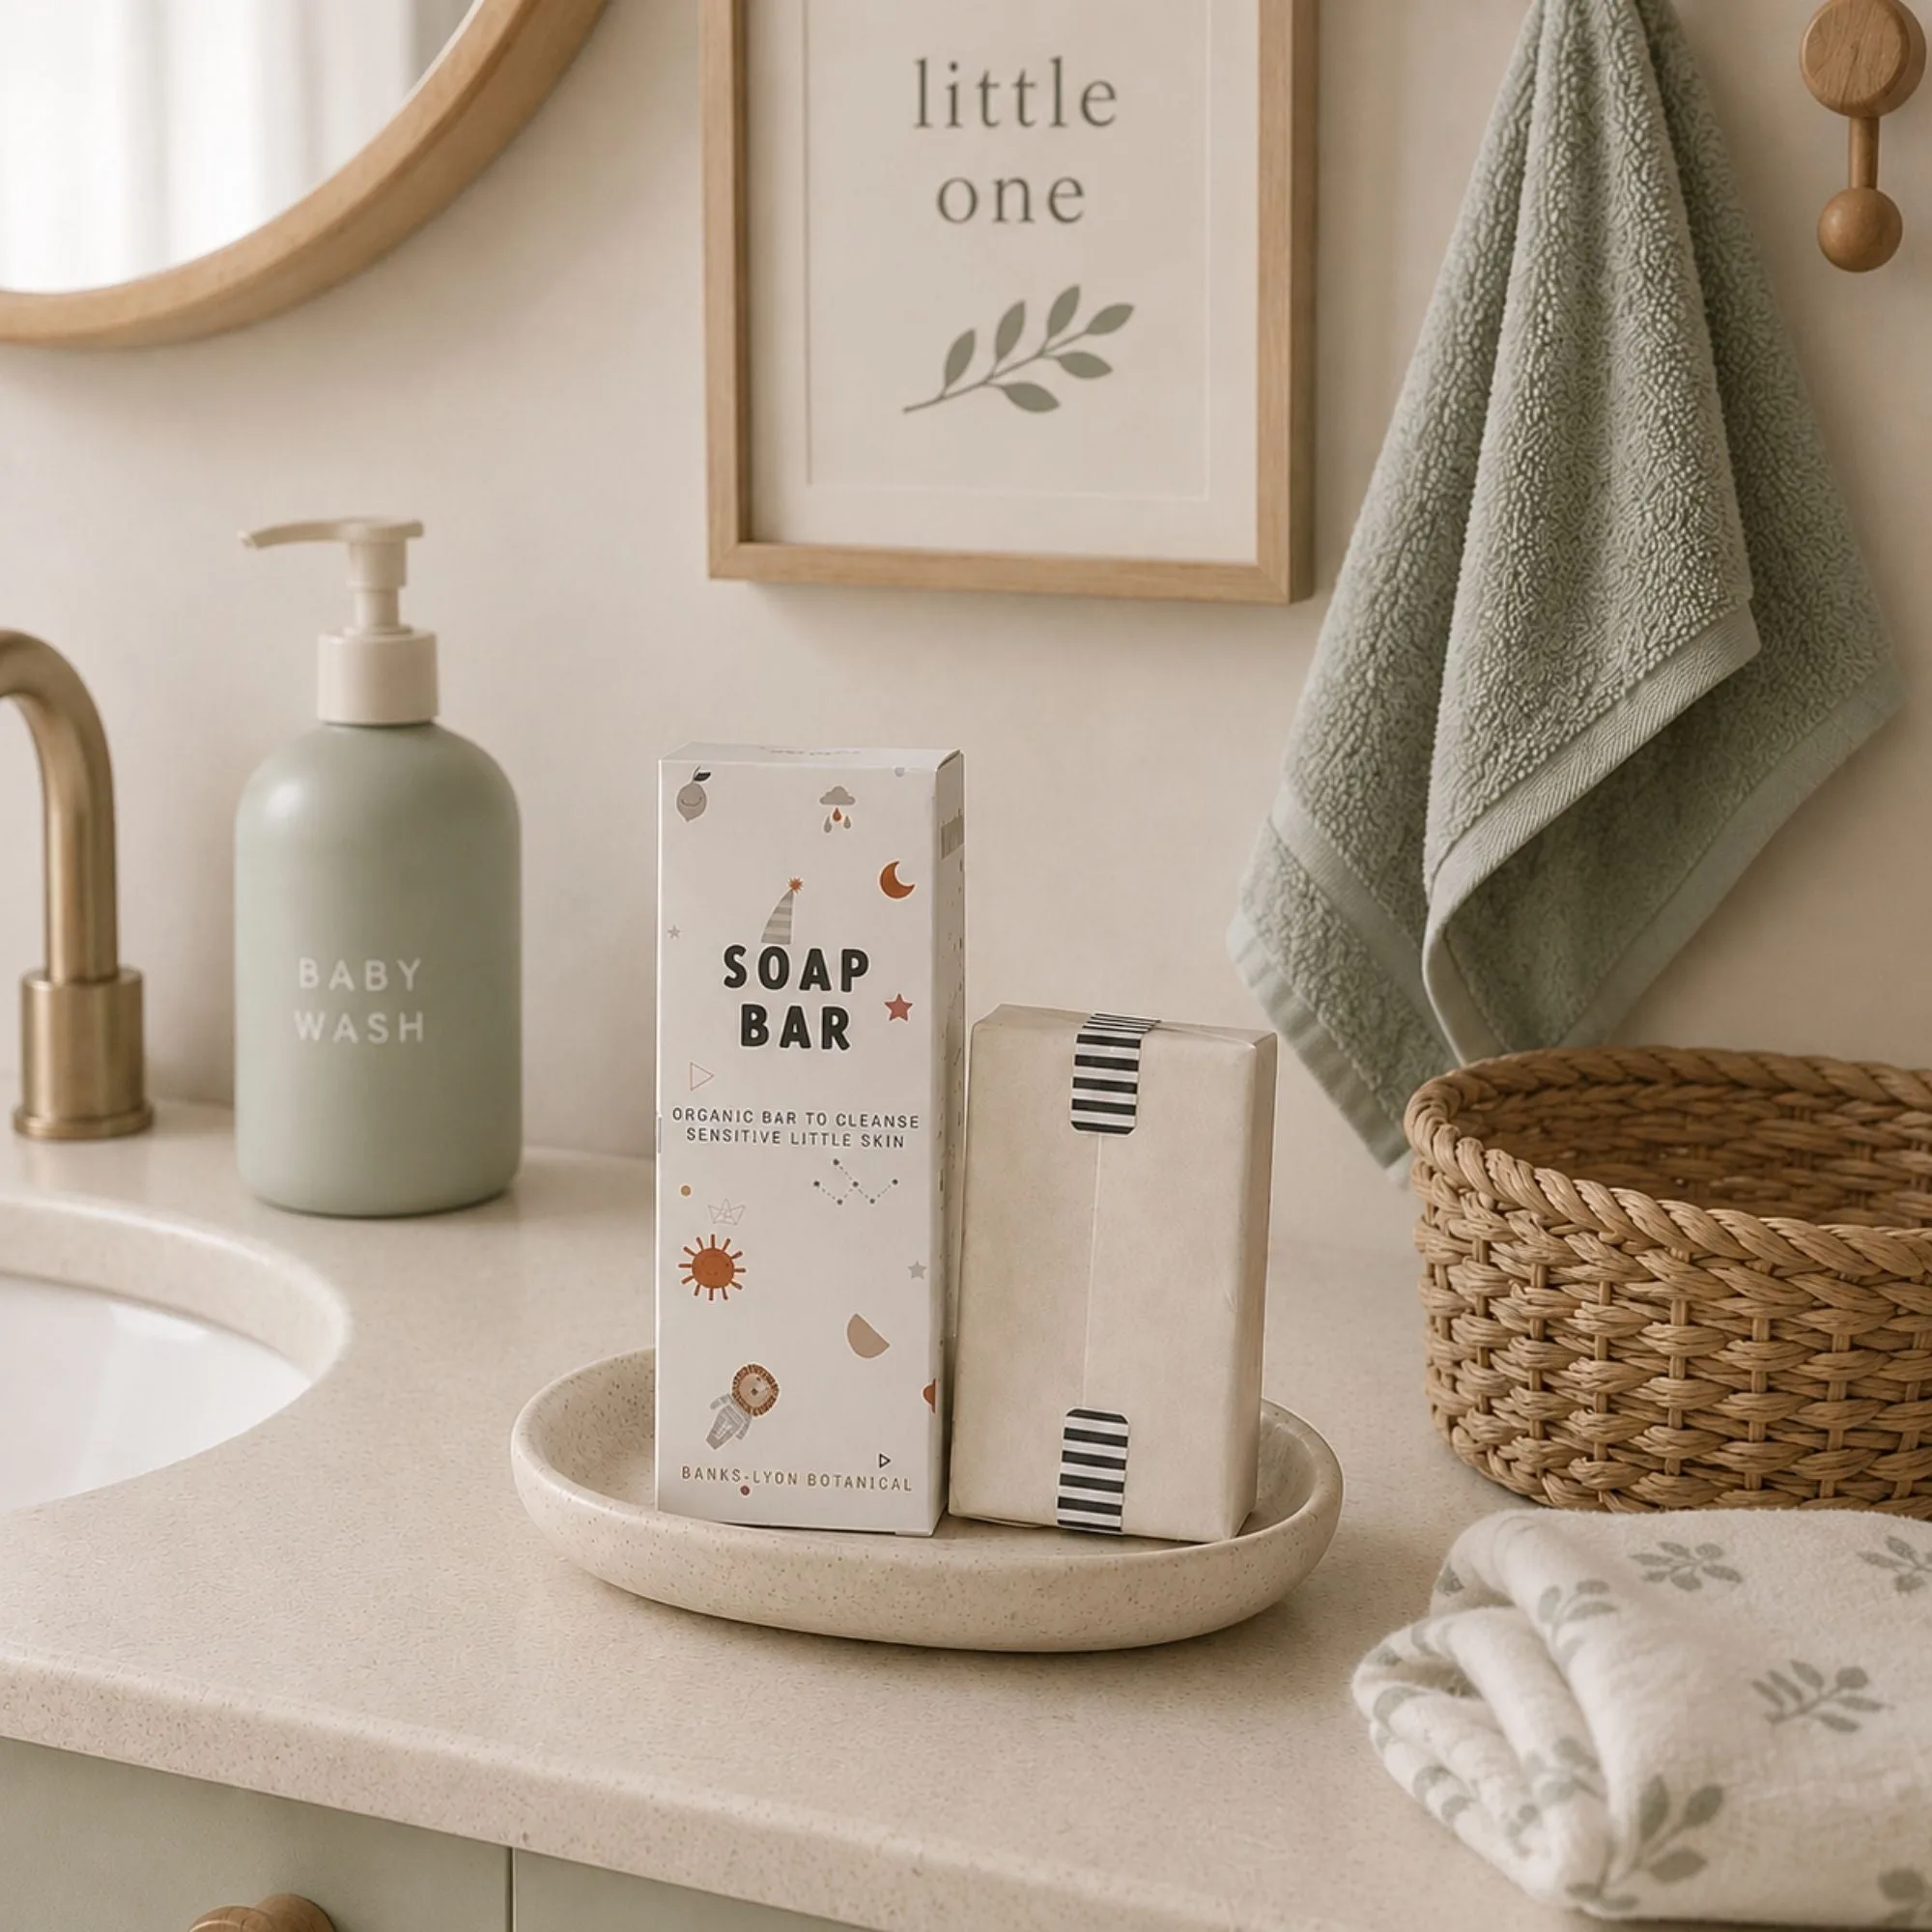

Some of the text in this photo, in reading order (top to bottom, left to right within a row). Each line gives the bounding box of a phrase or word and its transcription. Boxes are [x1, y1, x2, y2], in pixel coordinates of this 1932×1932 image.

[914, 56, 1118, 129] little
[936, 176, 1085, 225] one
[299, 956, 421, 991] BABY
[724, 945, 869, 993] SOAP
[294, 1010, 423, 1044] WASH
[740, 1003, 850, 1051] BAR
[672, 1107, 920, 1129] ORGANIC BAR TO CLEANSE
[686, 1126, 904, 1149] SENSITIVE LITTLE SKIN
[682, 1465, 913, 1492] BANKS-LYON BOTANICAL
